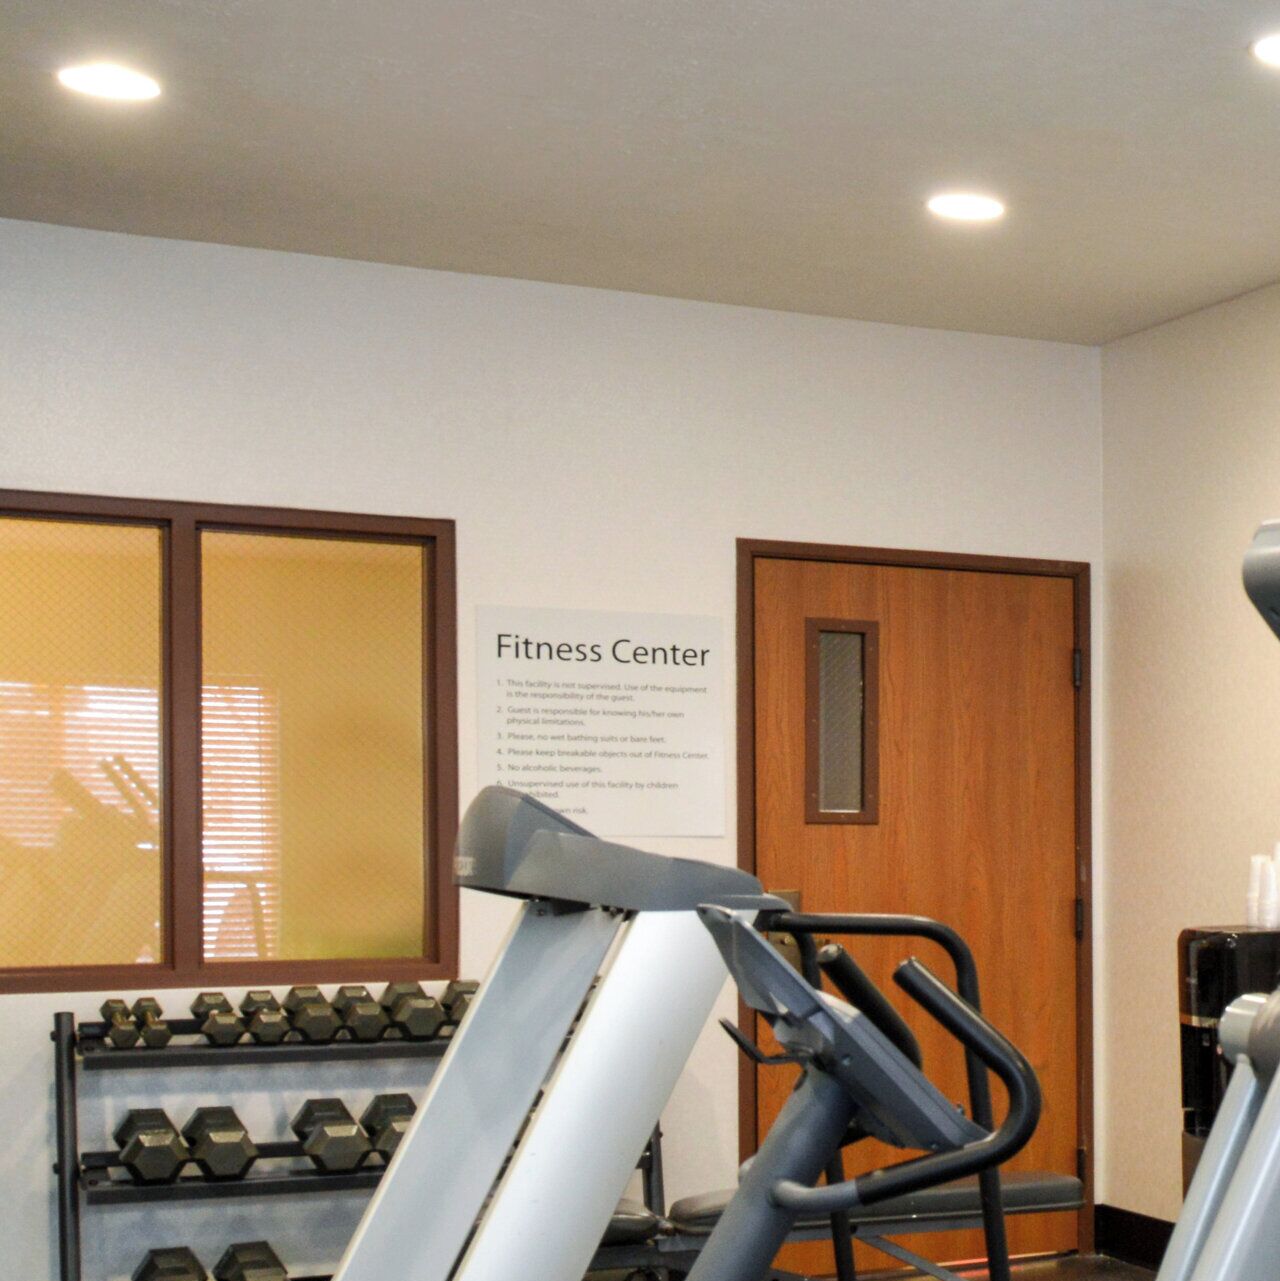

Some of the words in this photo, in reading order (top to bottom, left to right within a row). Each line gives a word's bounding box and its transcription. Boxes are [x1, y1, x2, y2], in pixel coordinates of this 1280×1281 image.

[496, 633, 602, 662] Fitness
[612, 638, 710, 666] Center
[507, 679, 523, 687] This
[525, 680, 552, 690] facility
[650, 684, 663, 692] the
[664, 686, 708, 694] equipment
[507, 706, 531, 714] Guest
[541, 707, 587, 716] responsible
[602, 709, 637, 718] knowing
[506, 718, 540, 726] physical
[566, 734, 598, 743] bathing
[630, 735, 647, 743] bare
[535, 749, 556, 757] keep
[557, 749, 597, 757] breakable
[598, 750, 627, 759] objects
[522, 764, 557, 772] alcoholic
[507, 780, 564, 788] Unsupervised
[581, 780, 590, 788] of
[607, 781, 634, 790] facility
[635, 781, 645, 790] by
[646, 781, 679, 789] children
